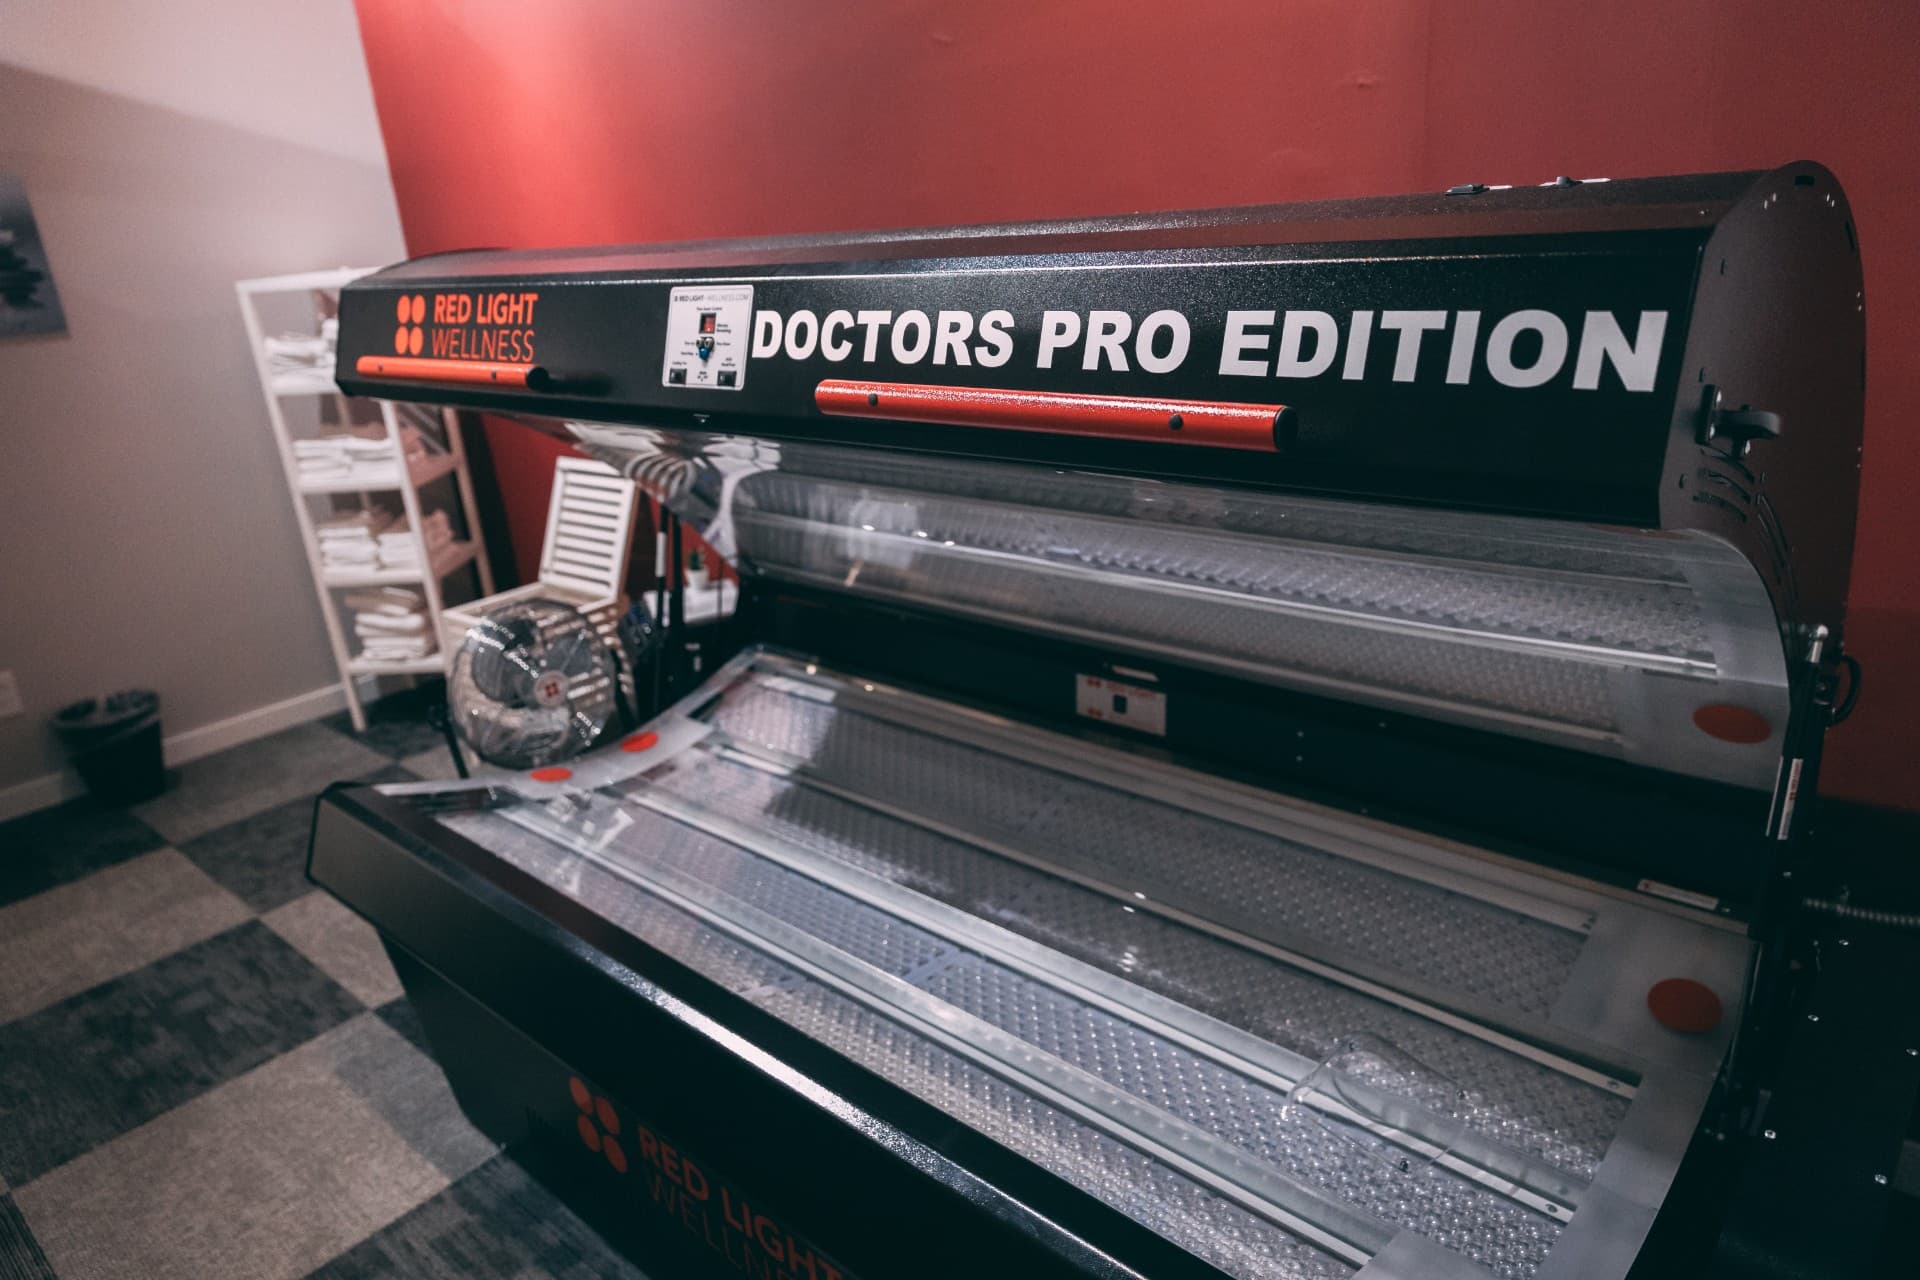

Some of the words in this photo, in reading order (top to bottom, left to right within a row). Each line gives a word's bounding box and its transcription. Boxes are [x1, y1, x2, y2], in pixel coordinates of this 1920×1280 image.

[433, 293, 472, 325] RED
[476, 292, 539, 326] LIGHT
[431, 327, 535, 363] WELLNESS
[751, 309, 1016, 368] DOCTORS
[1036, 309, 1191, 374] PRO
[1218, 309, 1669, 392] EDITION
[637, 1124, 709, 1201] RED
